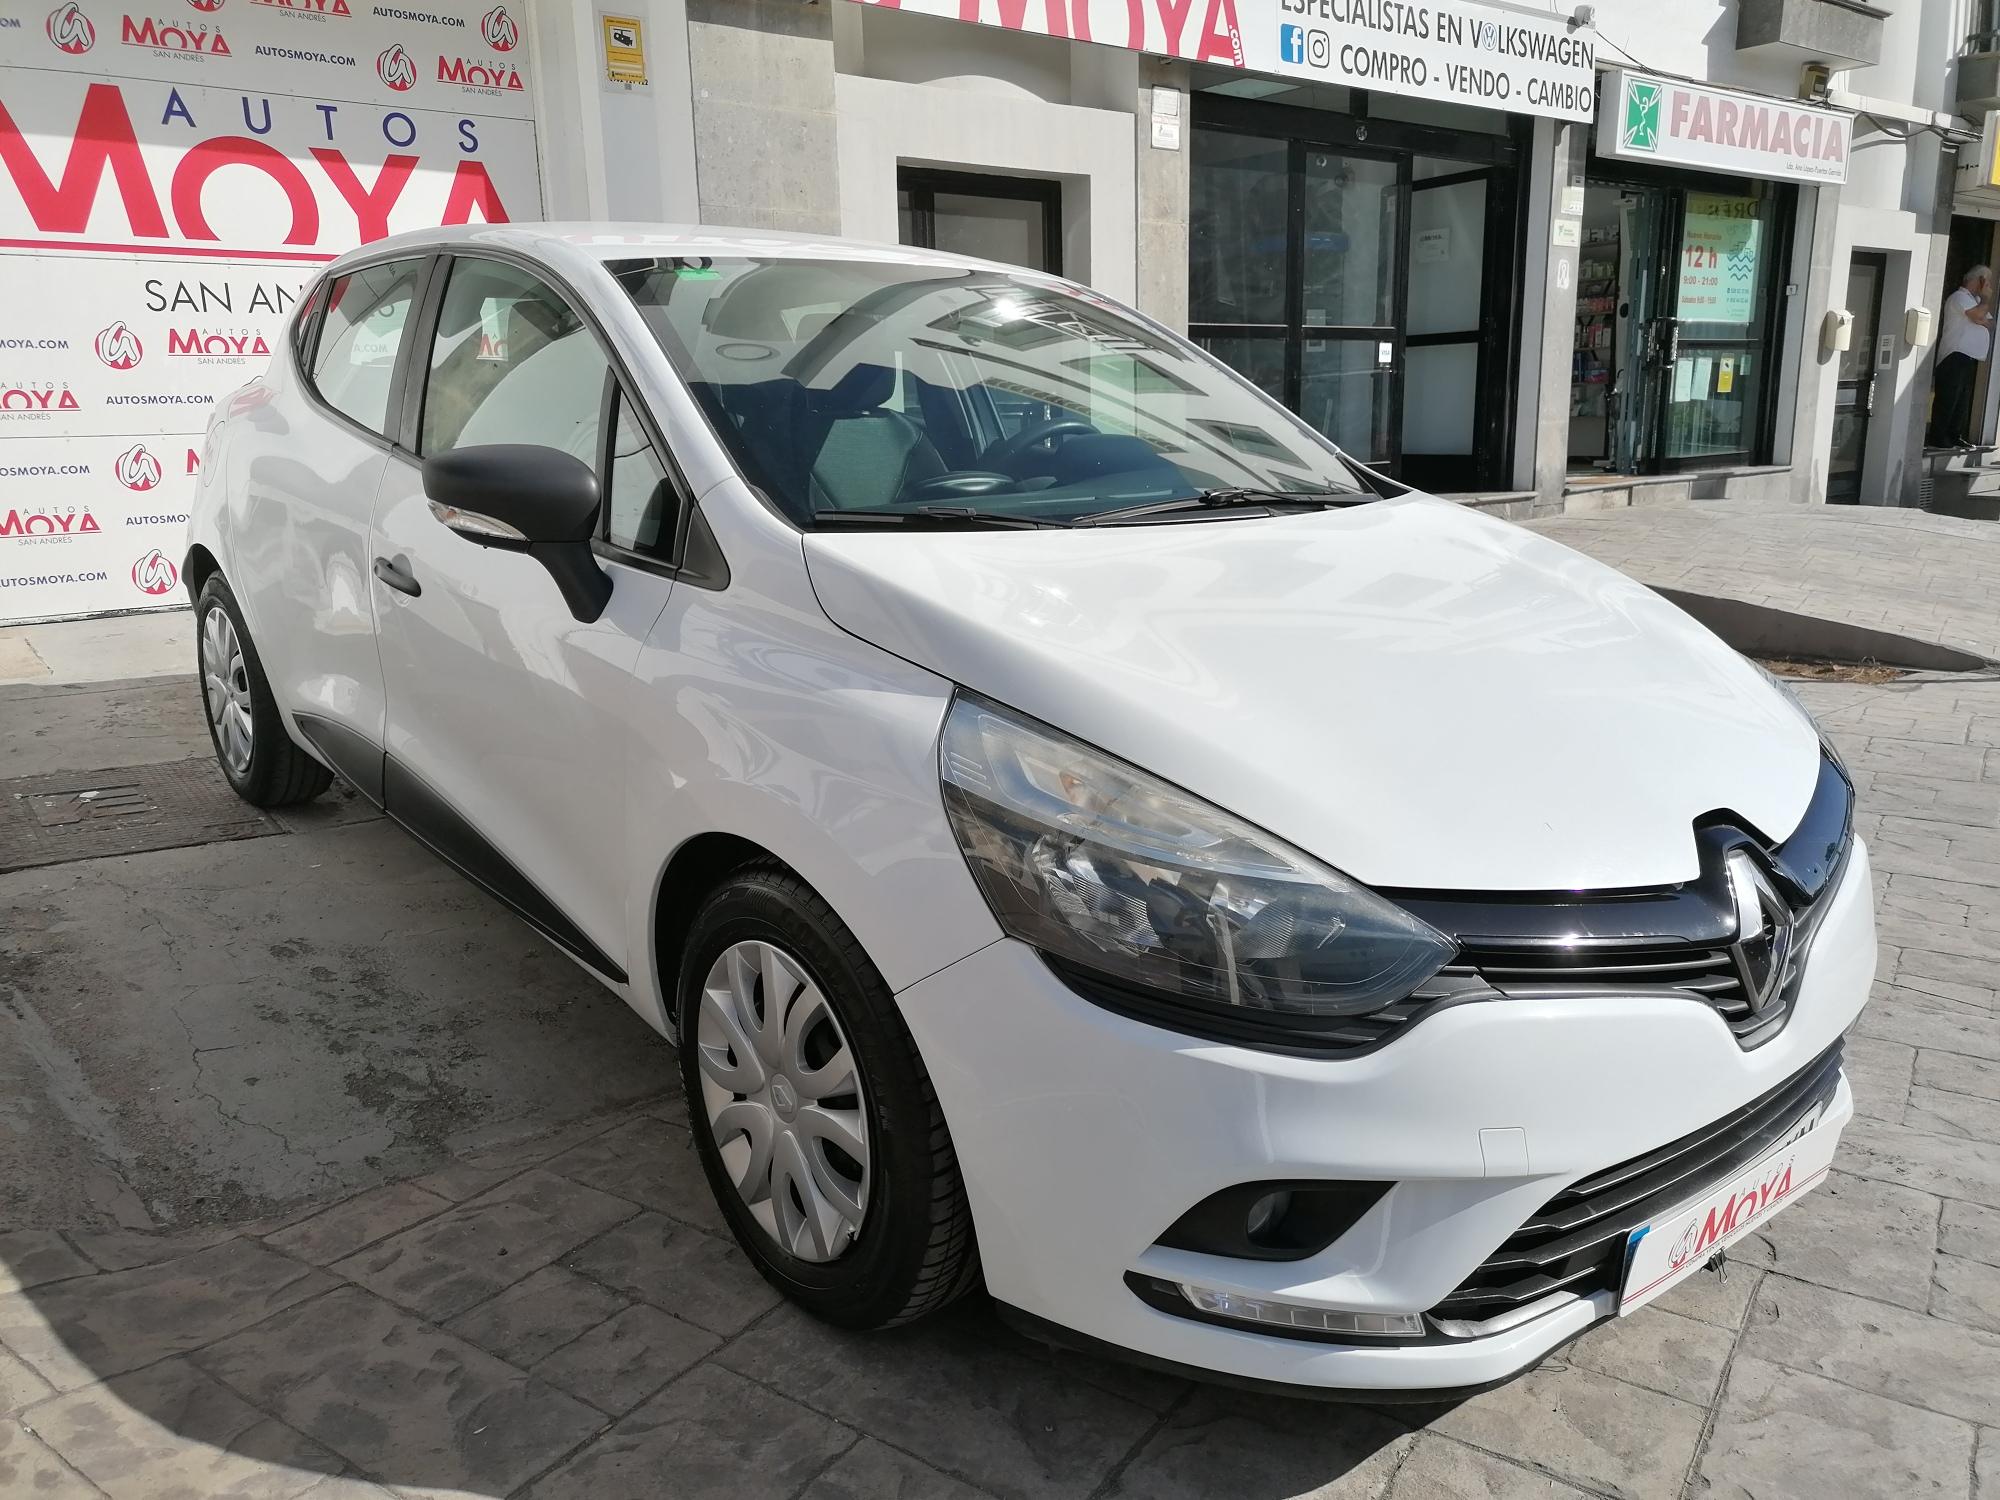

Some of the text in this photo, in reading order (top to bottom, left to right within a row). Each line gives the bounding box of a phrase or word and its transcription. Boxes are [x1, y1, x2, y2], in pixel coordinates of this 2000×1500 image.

[158, 18, 223, 33] AUTOS
[279, 10, 296, 18] SAN
[373, 6, 465, 27] AUTOSMOYA.COM
[121, 14, 231, 54] MOYA
[1437, 12, 1462, 45] EN
[152, 49, 171, 58] SAN
[255, 45, 356, 66] AUTOSMOYA.COM
[1229, 25, 1243, 66] .com
[437, 55, 524, 89] MOYA
[466, 58, 516, 71] AUTOS
[1340, 44, 1427, 86] COMPRO
[1446, 63, 1510, 100] VENDO
[1527, 78, 1592, 113] CAMBIO
[161, 87, 483, 153] AUTOS
[1669, 90, 1844, 163] FARMACIA
[0, 83, 512, 246] MOYA
[1685, 244, 1718, 269] 12 h
[145, 279, 233, 314] SAN
[168, 328, 271, 354] MOYA
[202, 328, 262, 336] AUTOS
[0, 381, 69, 390] AUTOS
[0, 389, 80, 409] OYA
[106, 395, 215, 405] AUTOSMOYA.COM
[23, 505, 91, 515] AUTOS
[0, 509, 101, 536] MOYA
[18, 538, 37, 546] SAN
[0, 571, 108, 588] UTOSMOYA.COM
[1694, 1166, 1792, 1255] MOYA
